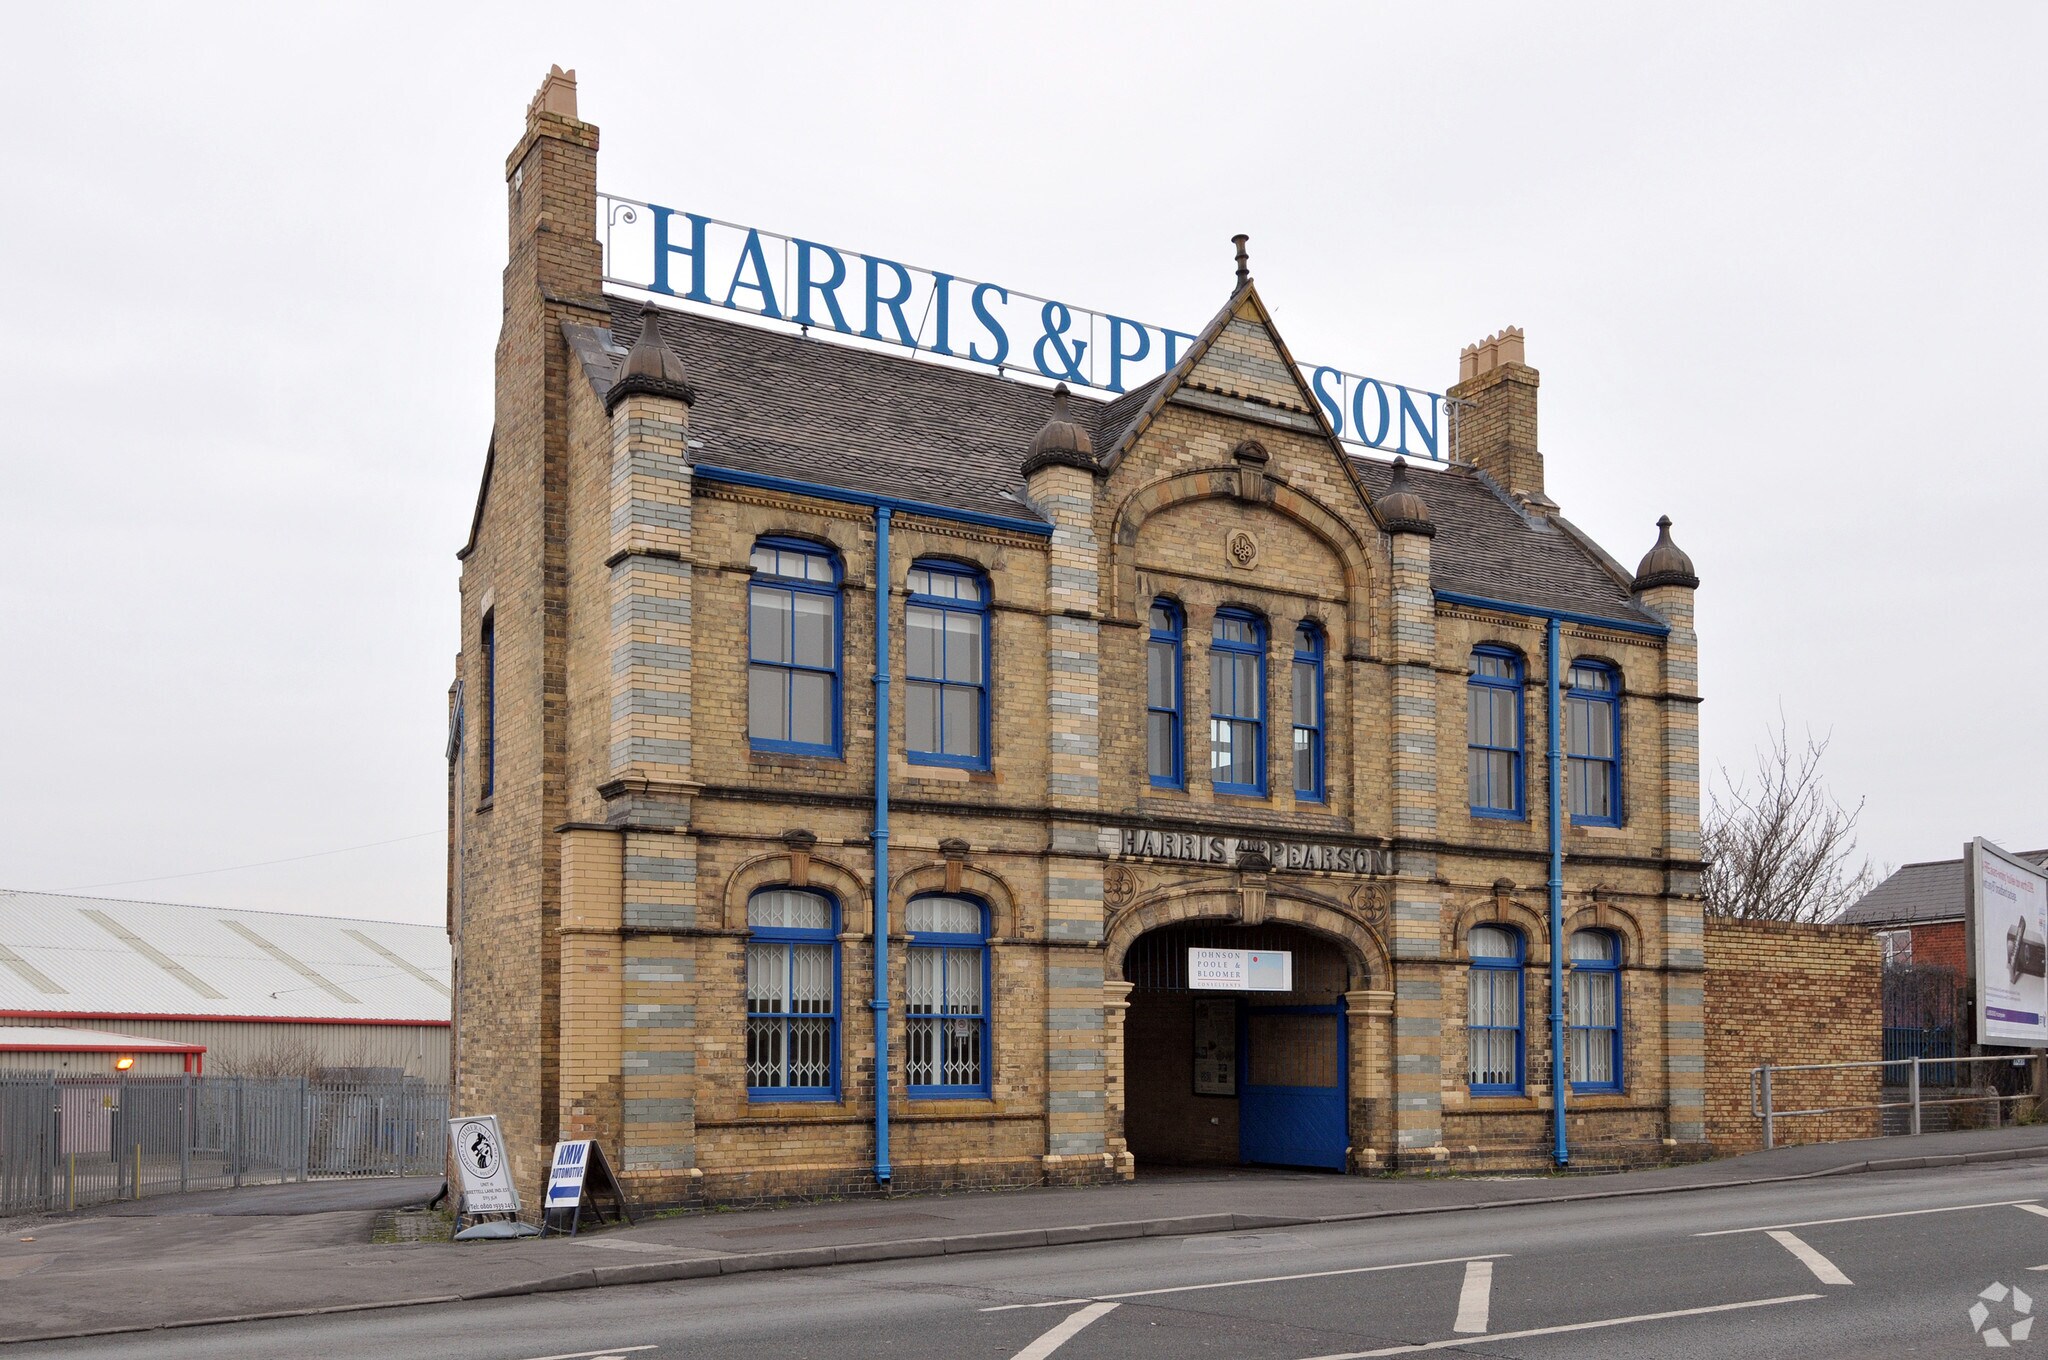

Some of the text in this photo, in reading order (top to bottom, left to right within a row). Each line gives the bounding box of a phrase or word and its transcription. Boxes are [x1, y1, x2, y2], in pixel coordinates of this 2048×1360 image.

[648, 203, 1009, 366] HARRIS
[1033, 300, 1090, 387] &
[1120, 829, 1390, 876] HARRIS AND PEARSON
[1197, 951, 1240, 959] JOHNSON
[557, 1144, 585, 1165] KMW
[551, 1167, 584, 1178] AUTOMOTIVE
